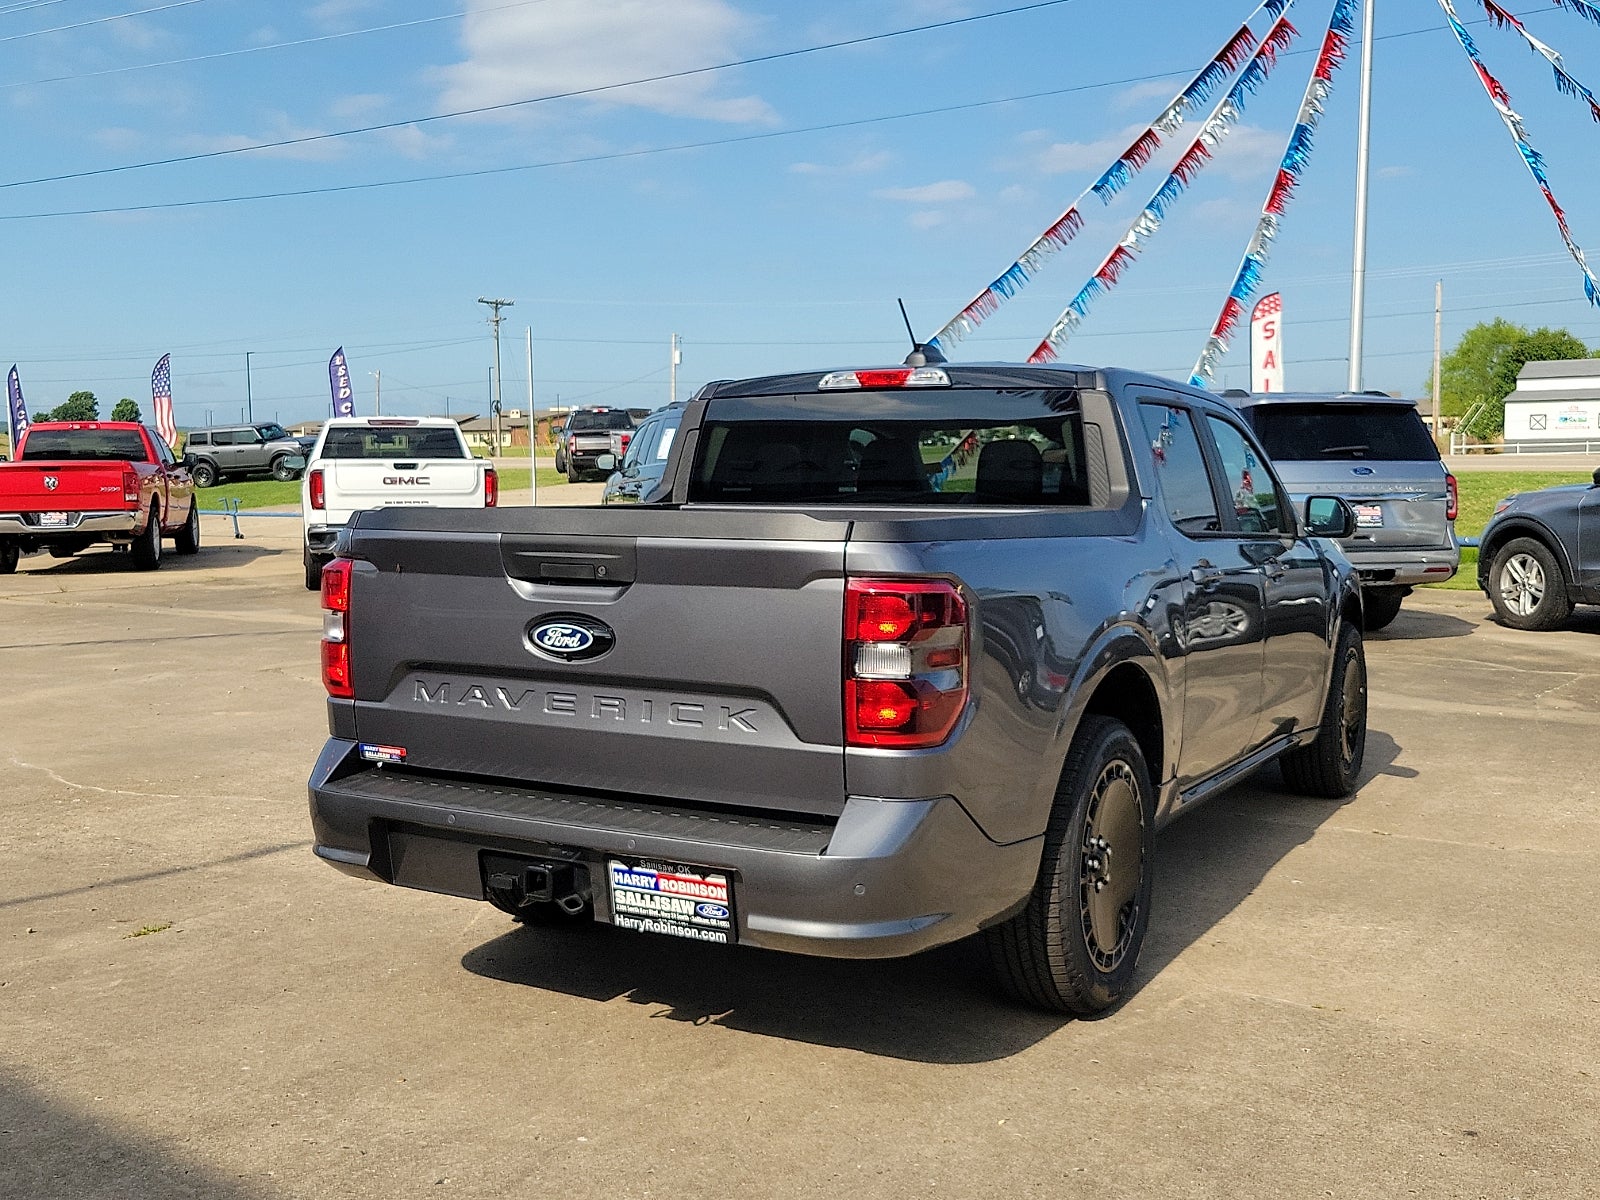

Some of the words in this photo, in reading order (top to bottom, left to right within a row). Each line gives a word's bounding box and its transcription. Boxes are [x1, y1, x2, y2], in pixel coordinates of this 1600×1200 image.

[335, 355, 351, 400] USED
[382, 476, 431, 485] GMC
[543, 627, 582, 648] Ford
[413, 679, 759, 734] MAVERICK
[677, 864, 691, 873] OK
[614, 871, 657, 889] HARRY
[659, 878, 727, 900] ROBINSON
[614, 889, 696, 916] SALLISAW
[614, 914, 728, 944] HarryRobinson.com
